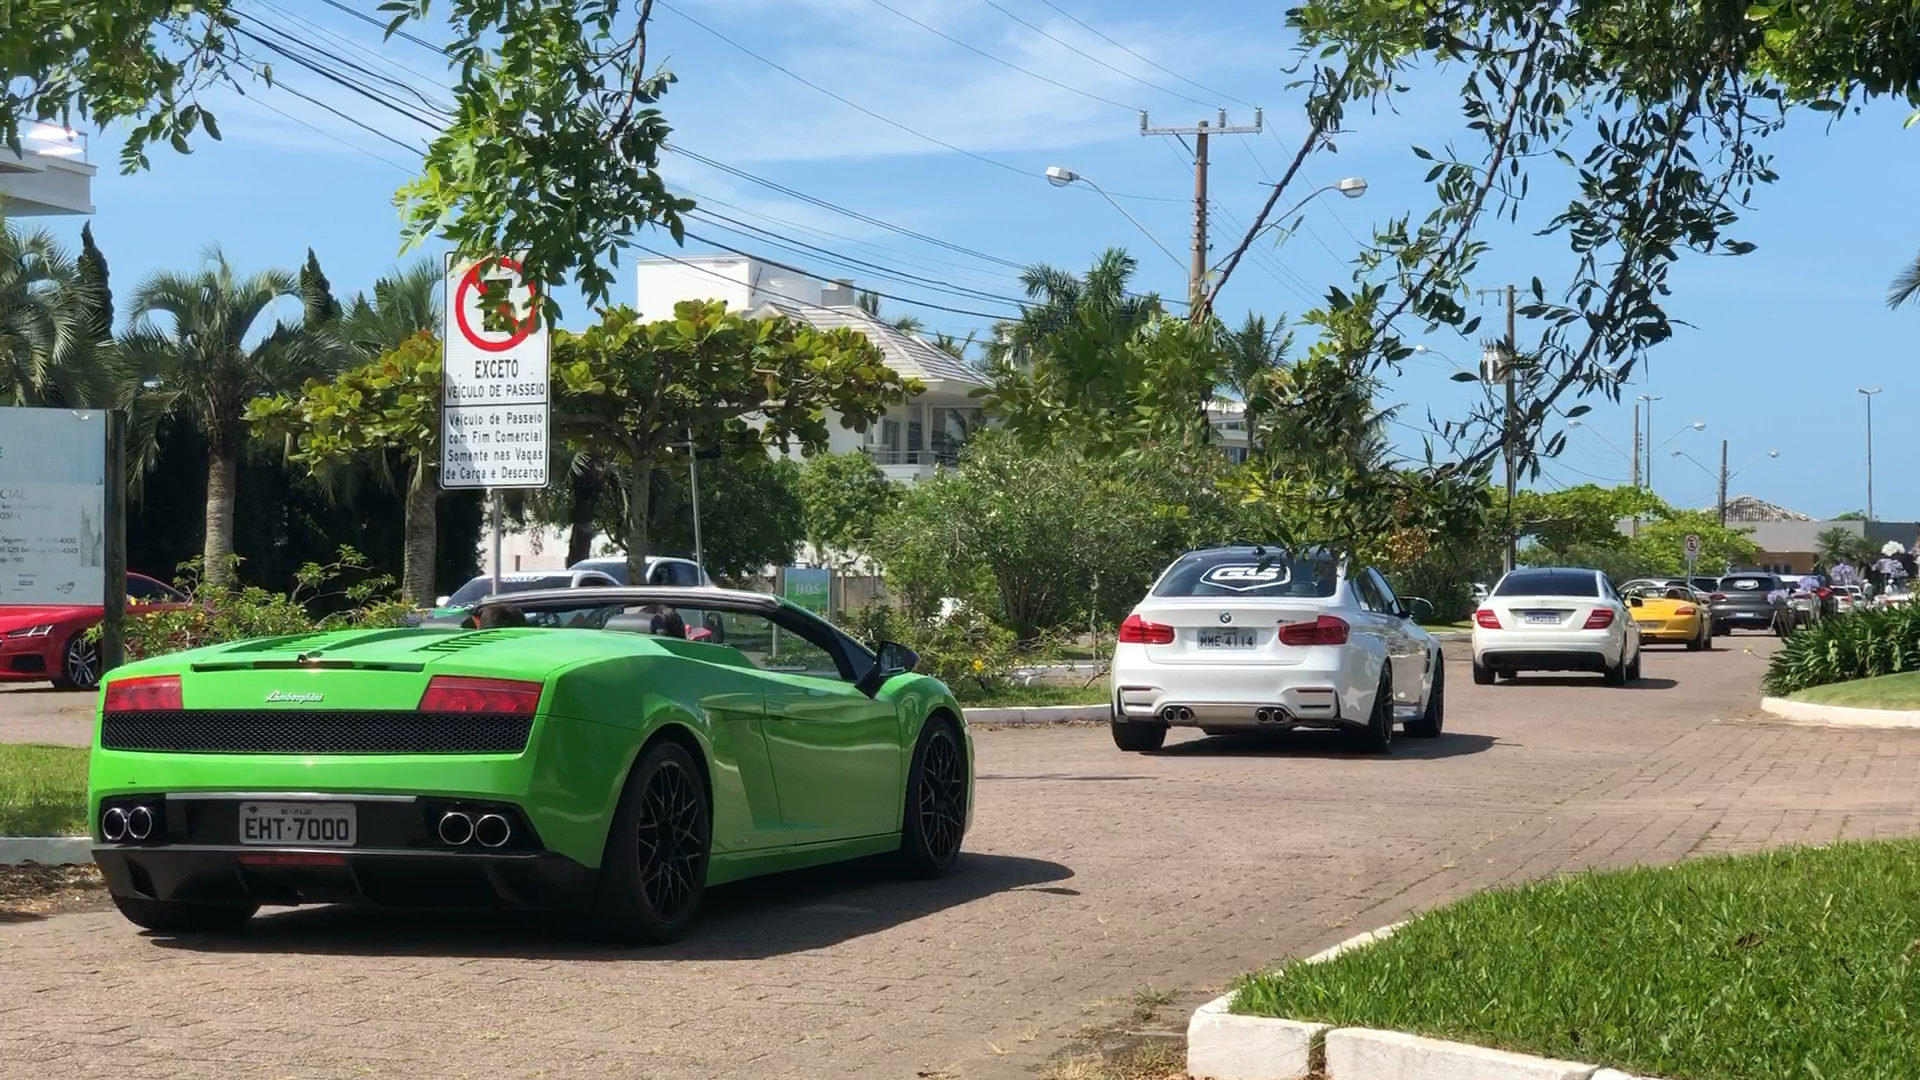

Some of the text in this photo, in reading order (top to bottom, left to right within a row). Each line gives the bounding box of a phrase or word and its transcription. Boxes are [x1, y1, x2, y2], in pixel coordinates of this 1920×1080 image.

[475, 359, 519, 379] EXCETO
[489, 384, 502, 397] DE
[506, 382, 545, 397] PASSEIO
[489, 413, 501, 425] de
[506, 411, 543, 425] Passeio
[449, 429, 543, 444] com Fim Comercial
[448, 447, 544, 463] Somente nas Vagas
[445, 466, 544, 483] de Carga e Descarga
